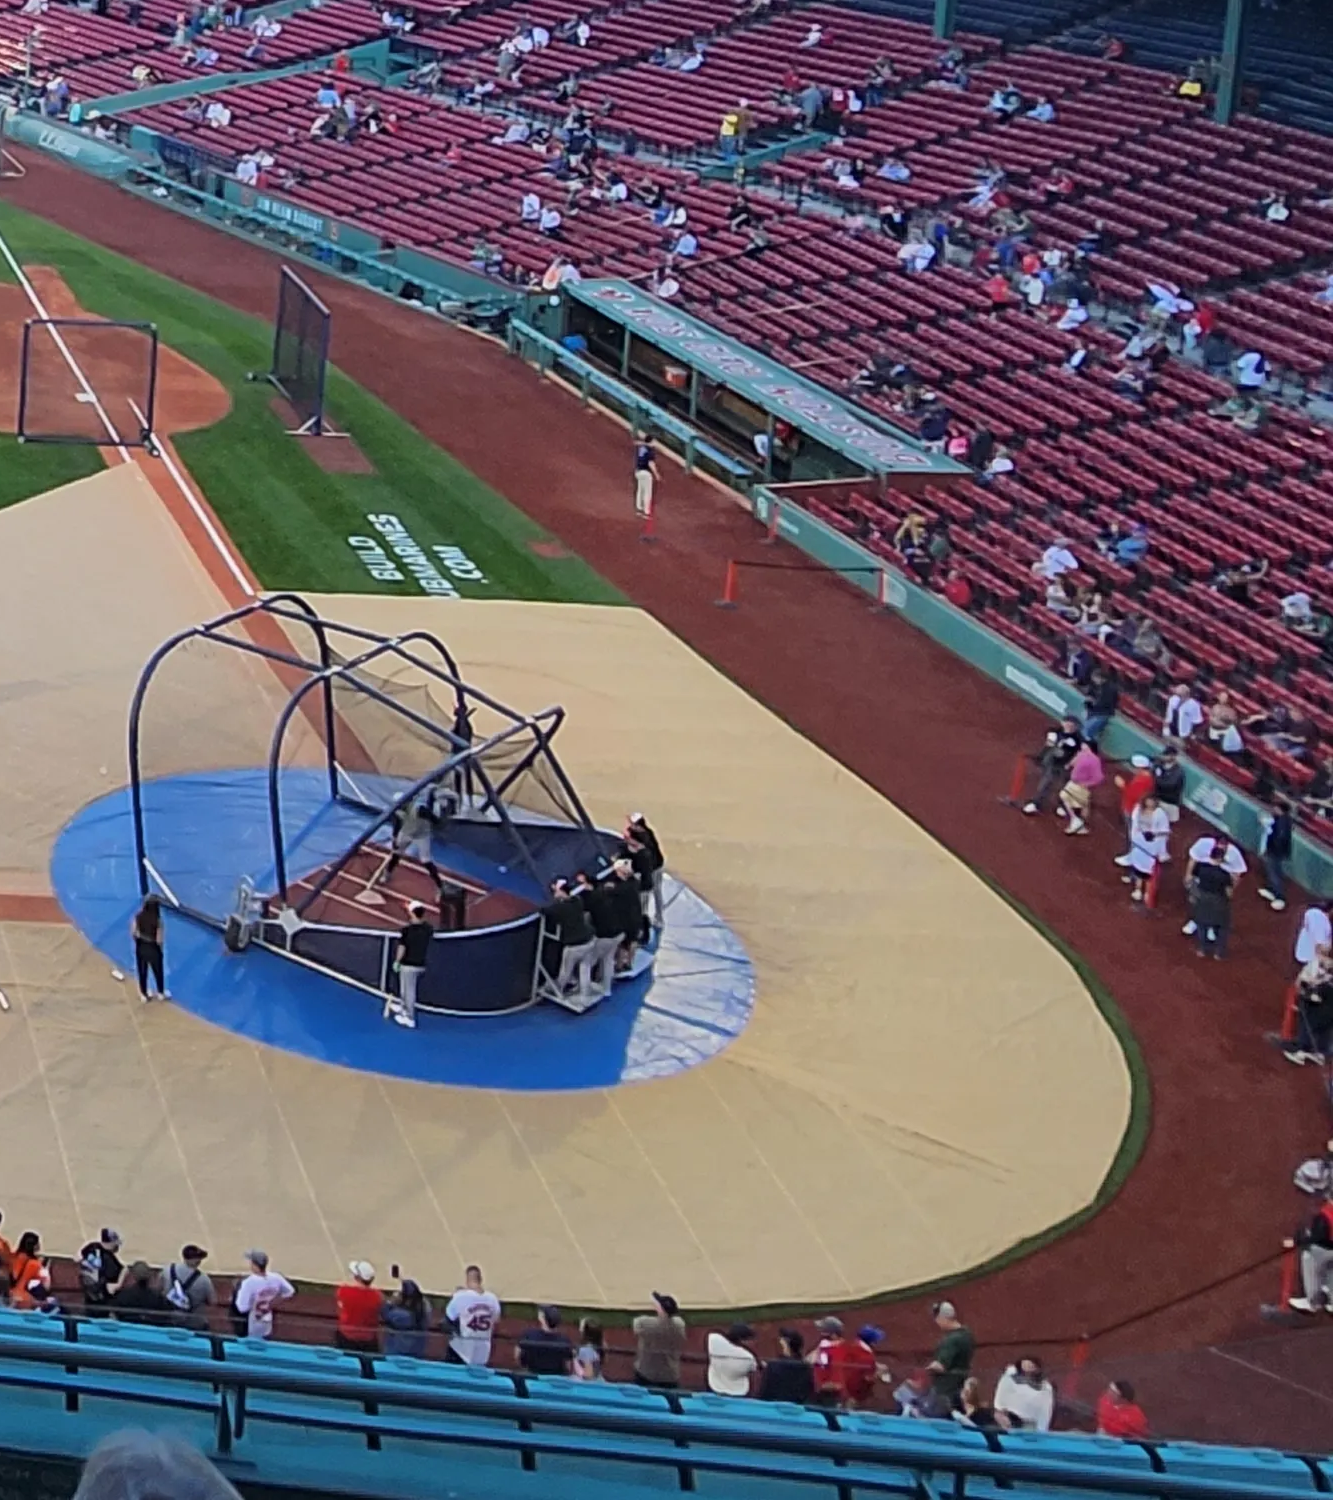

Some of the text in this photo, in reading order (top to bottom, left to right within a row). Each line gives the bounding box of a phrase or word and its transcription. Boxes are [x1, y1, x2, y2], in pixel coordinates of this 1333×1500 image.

[347, 535, 405, 582] BUILD
[432, 544, 490, 585] .COM
[466, 1314, 493, 1333] 45
